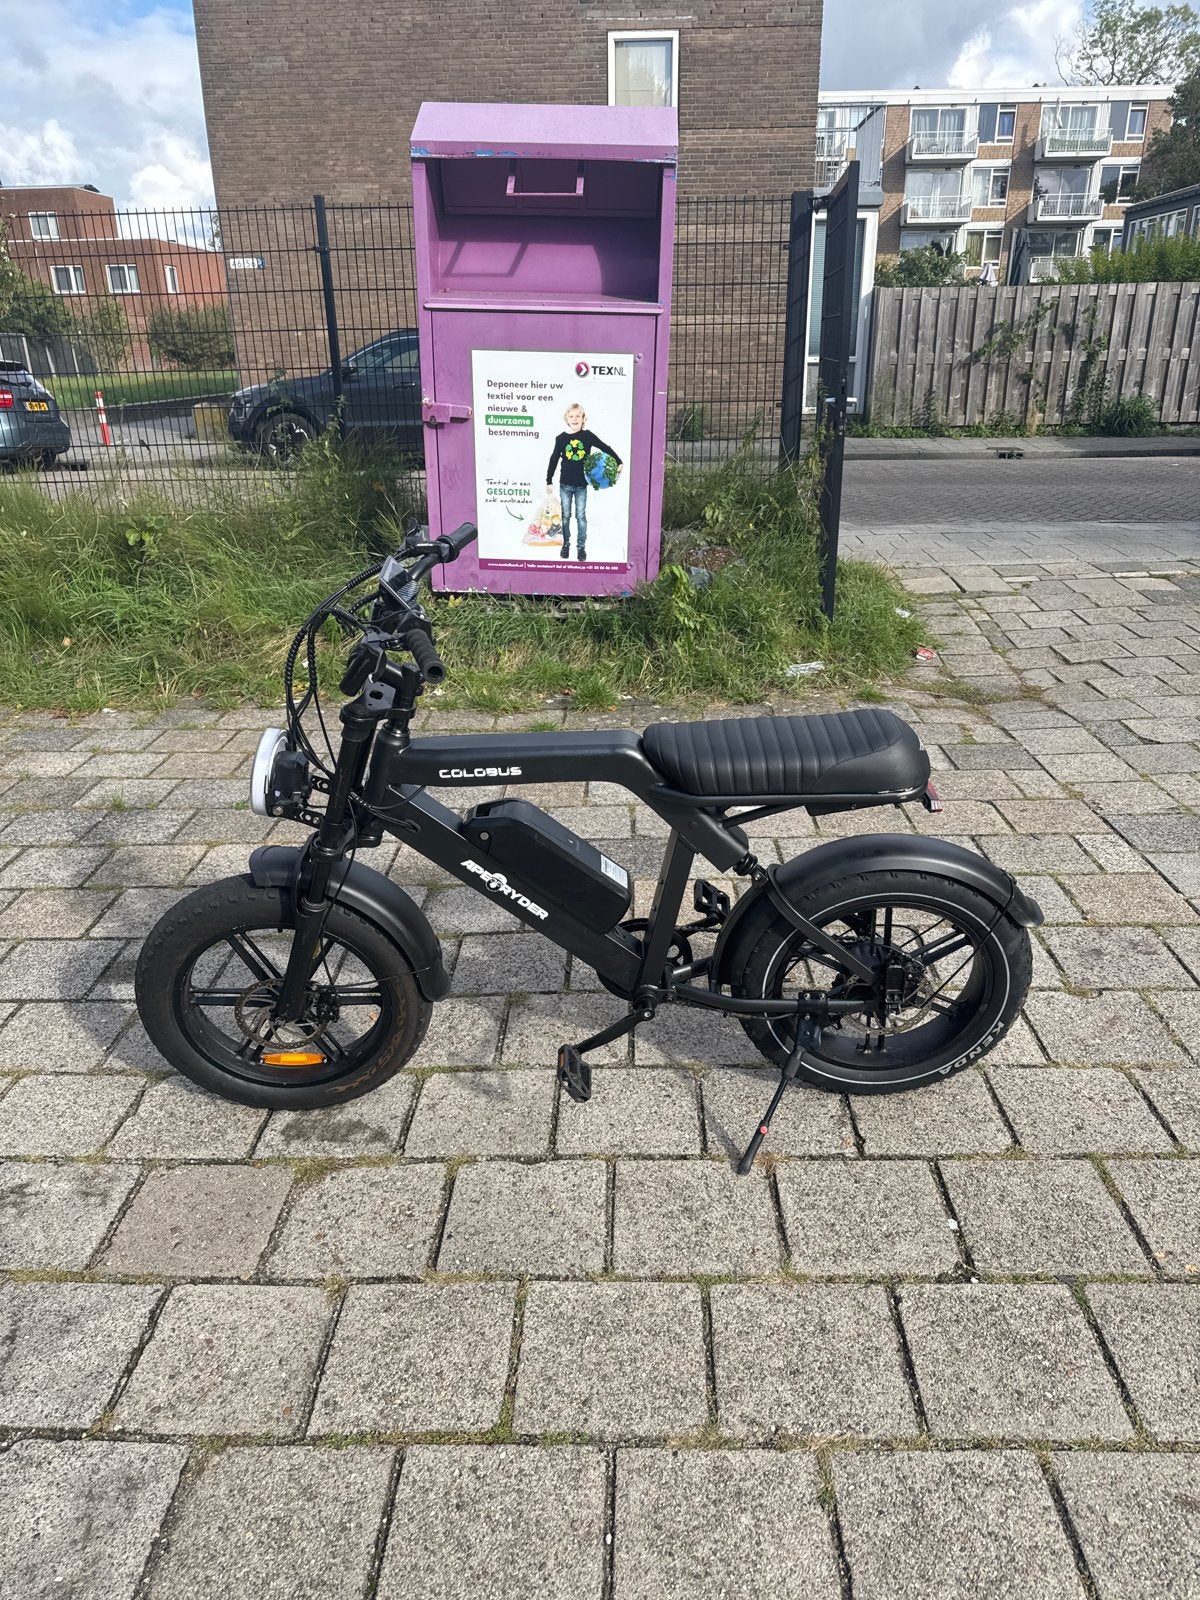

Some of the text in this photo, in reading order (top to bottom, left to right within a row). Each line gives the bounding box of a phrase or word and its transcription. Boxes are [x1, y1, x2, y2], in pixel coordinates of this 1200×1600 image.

[591, 365, 627, 376] TEXNL
[487, 379, 528, 390] Deponeer
[530, 380, 547, 389] hier
[487, 392, 514, 401] textiel
[487, 404, 528, 413] nieuwe &
[487, 416, 531, 425] duurzame
[488, 428, 540, 439] bestemming
[486, 487, 531, 497] GESLOTEN
[438, 766, 523, 779] COLOBUS
[939, 1021, 1005, 1075] KENDA
